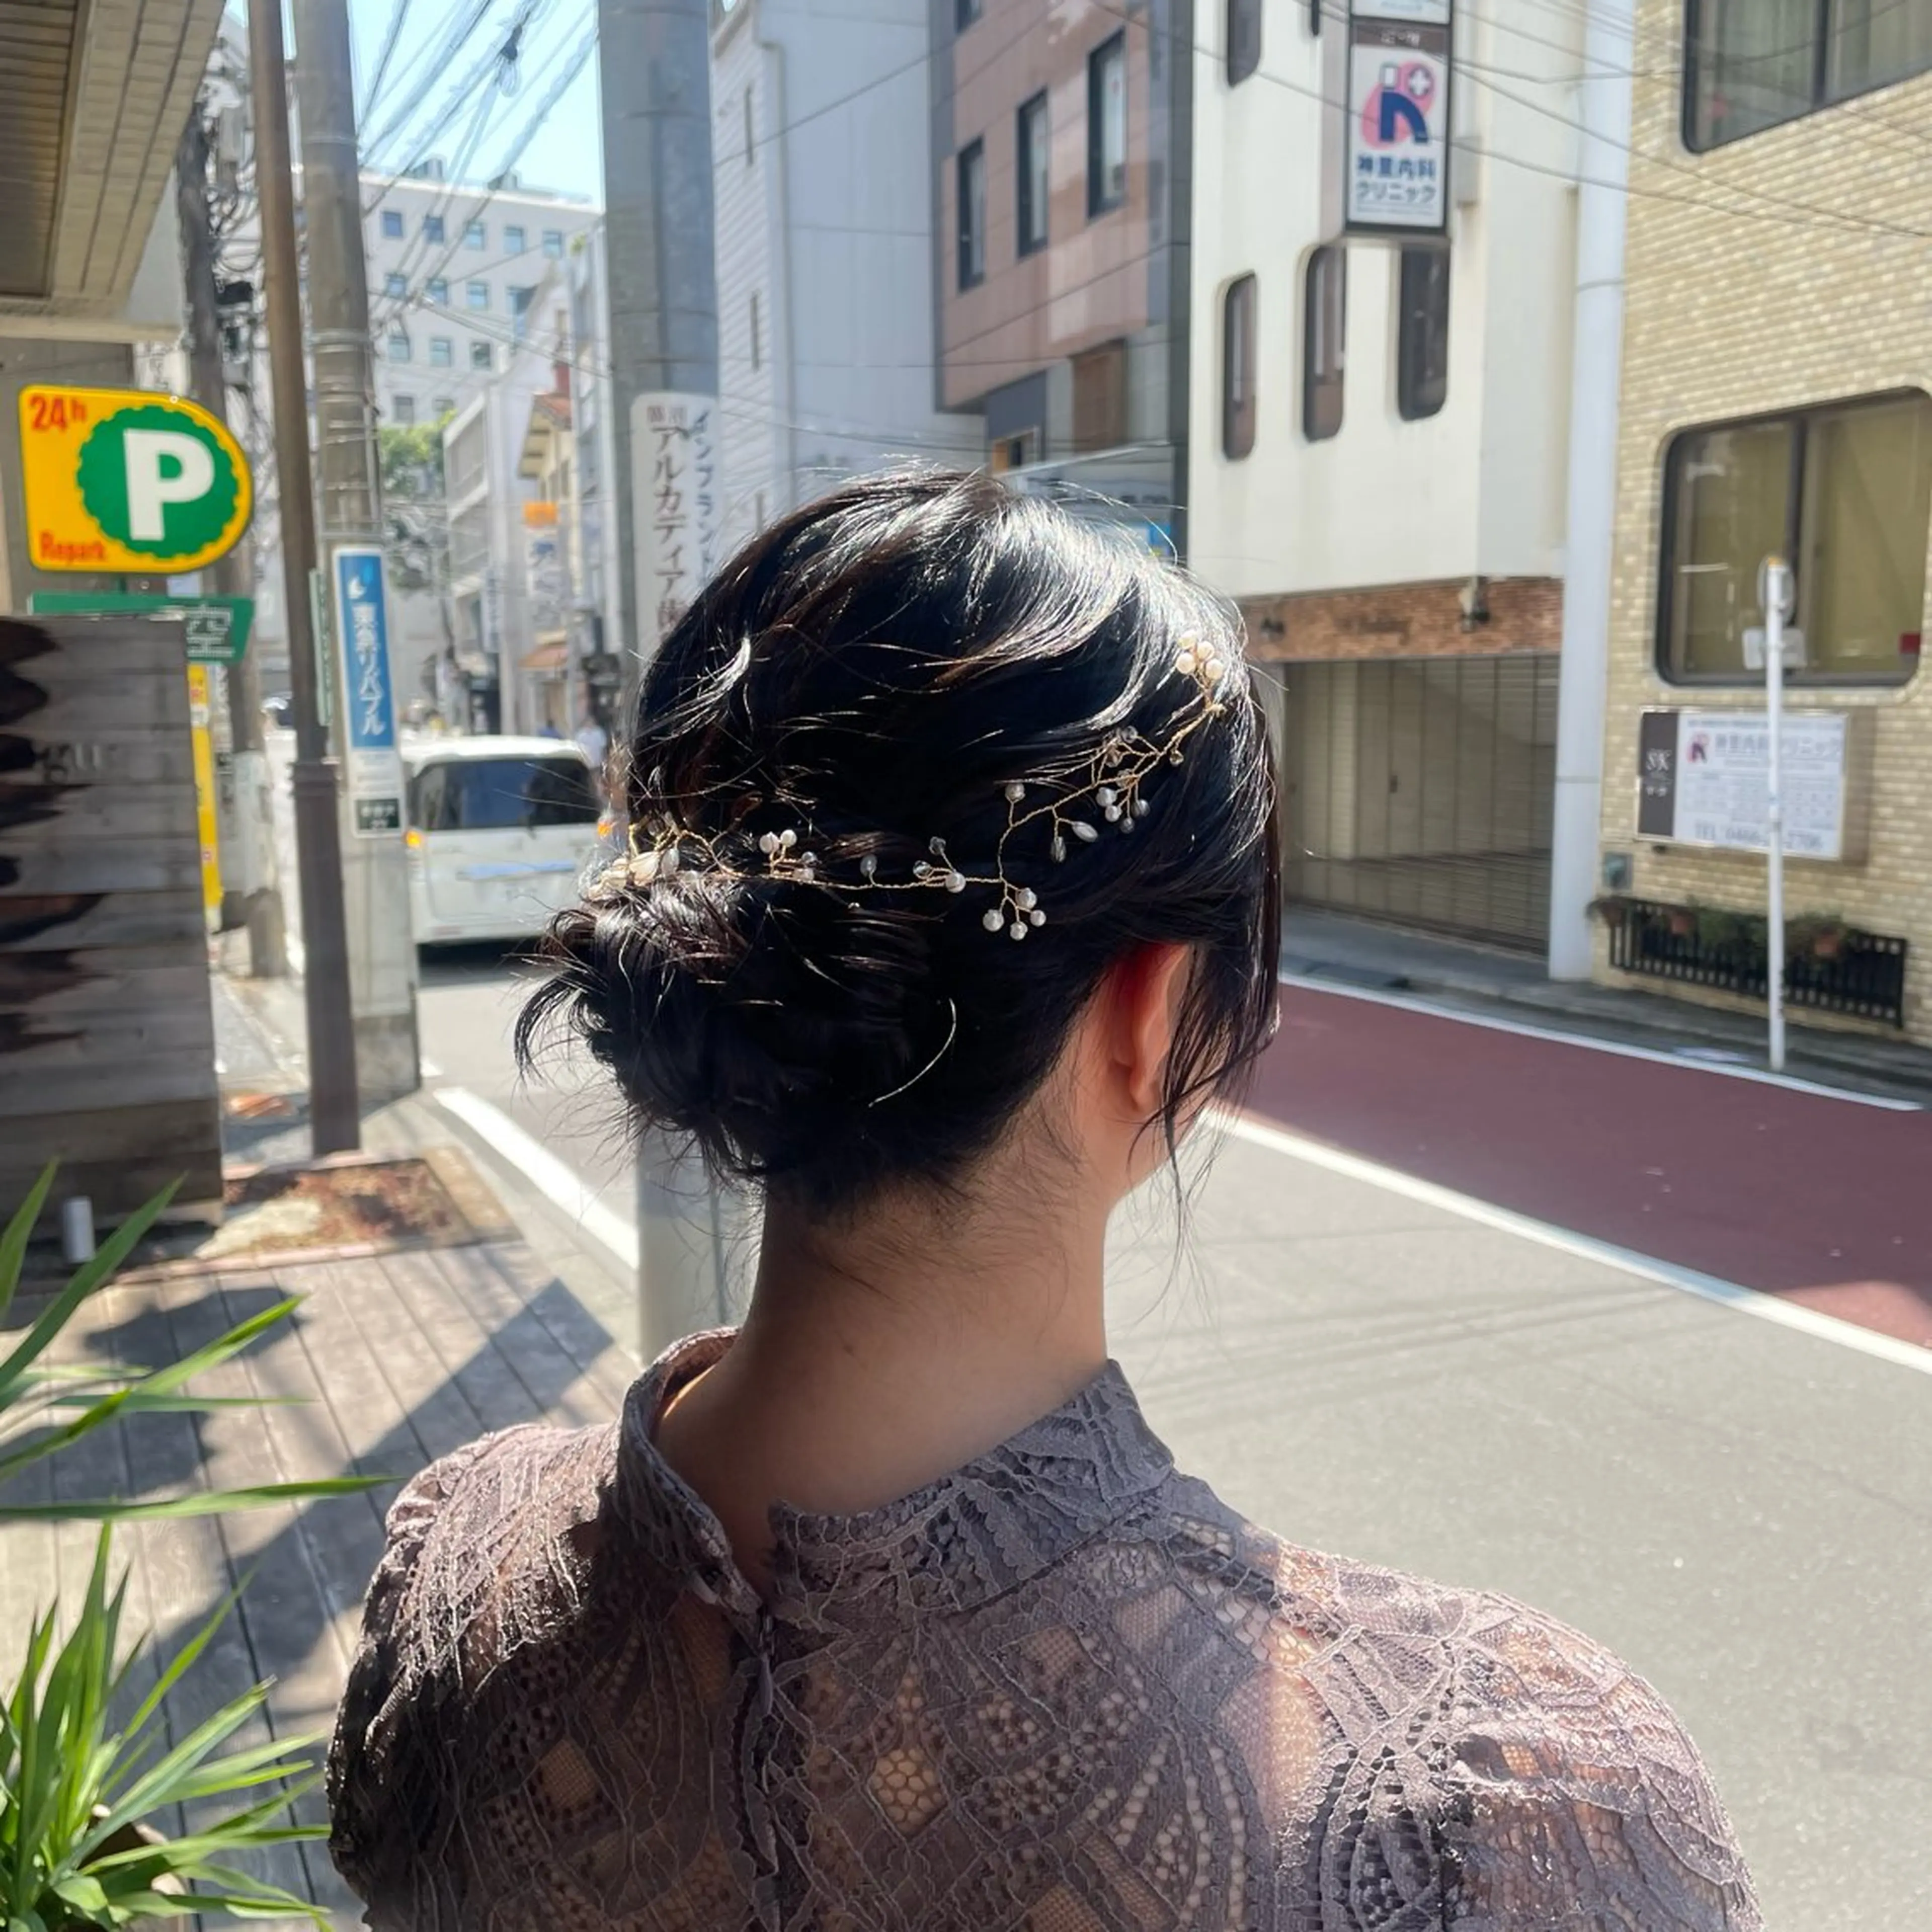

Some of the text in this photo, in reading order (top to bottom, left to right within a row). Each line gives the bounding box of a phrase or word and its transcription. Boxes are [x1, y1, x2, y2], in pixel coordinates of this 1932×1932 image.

[1356, 180, 1437, 203] クリニック
[29, 395, 87, 430] 24h
[122, 428, 215, 541] P
[353, 604, 386, 736] 東急リバブル
